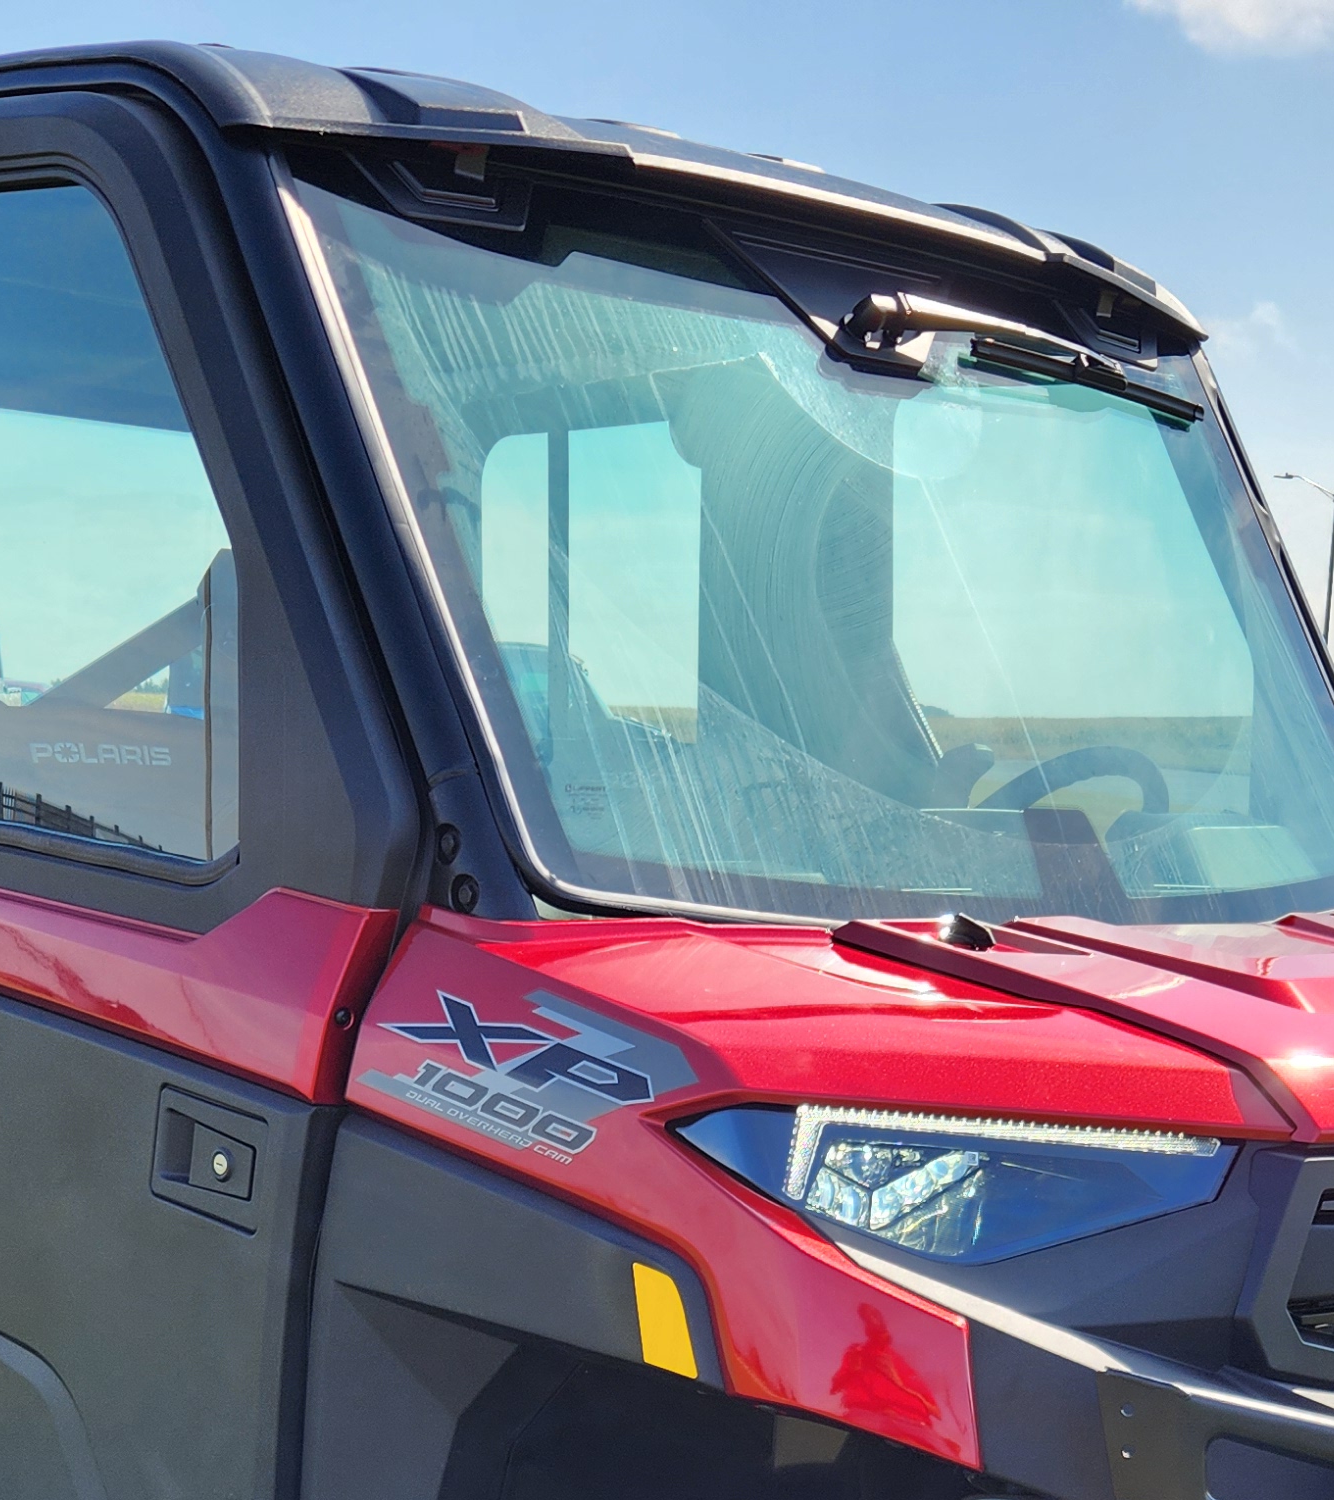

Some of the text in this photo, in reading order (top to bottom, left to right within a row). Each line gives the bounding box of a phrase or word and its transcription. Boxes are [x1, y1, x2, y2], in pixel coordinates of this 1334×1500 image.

[29, 742, 172, 766] POLARIS
[376, 989, 655, 1105] XP
[405, 1090, 573, 1165] DUAL OVERHEAD CAM
[411, 1059, 597, 1155] 1000
